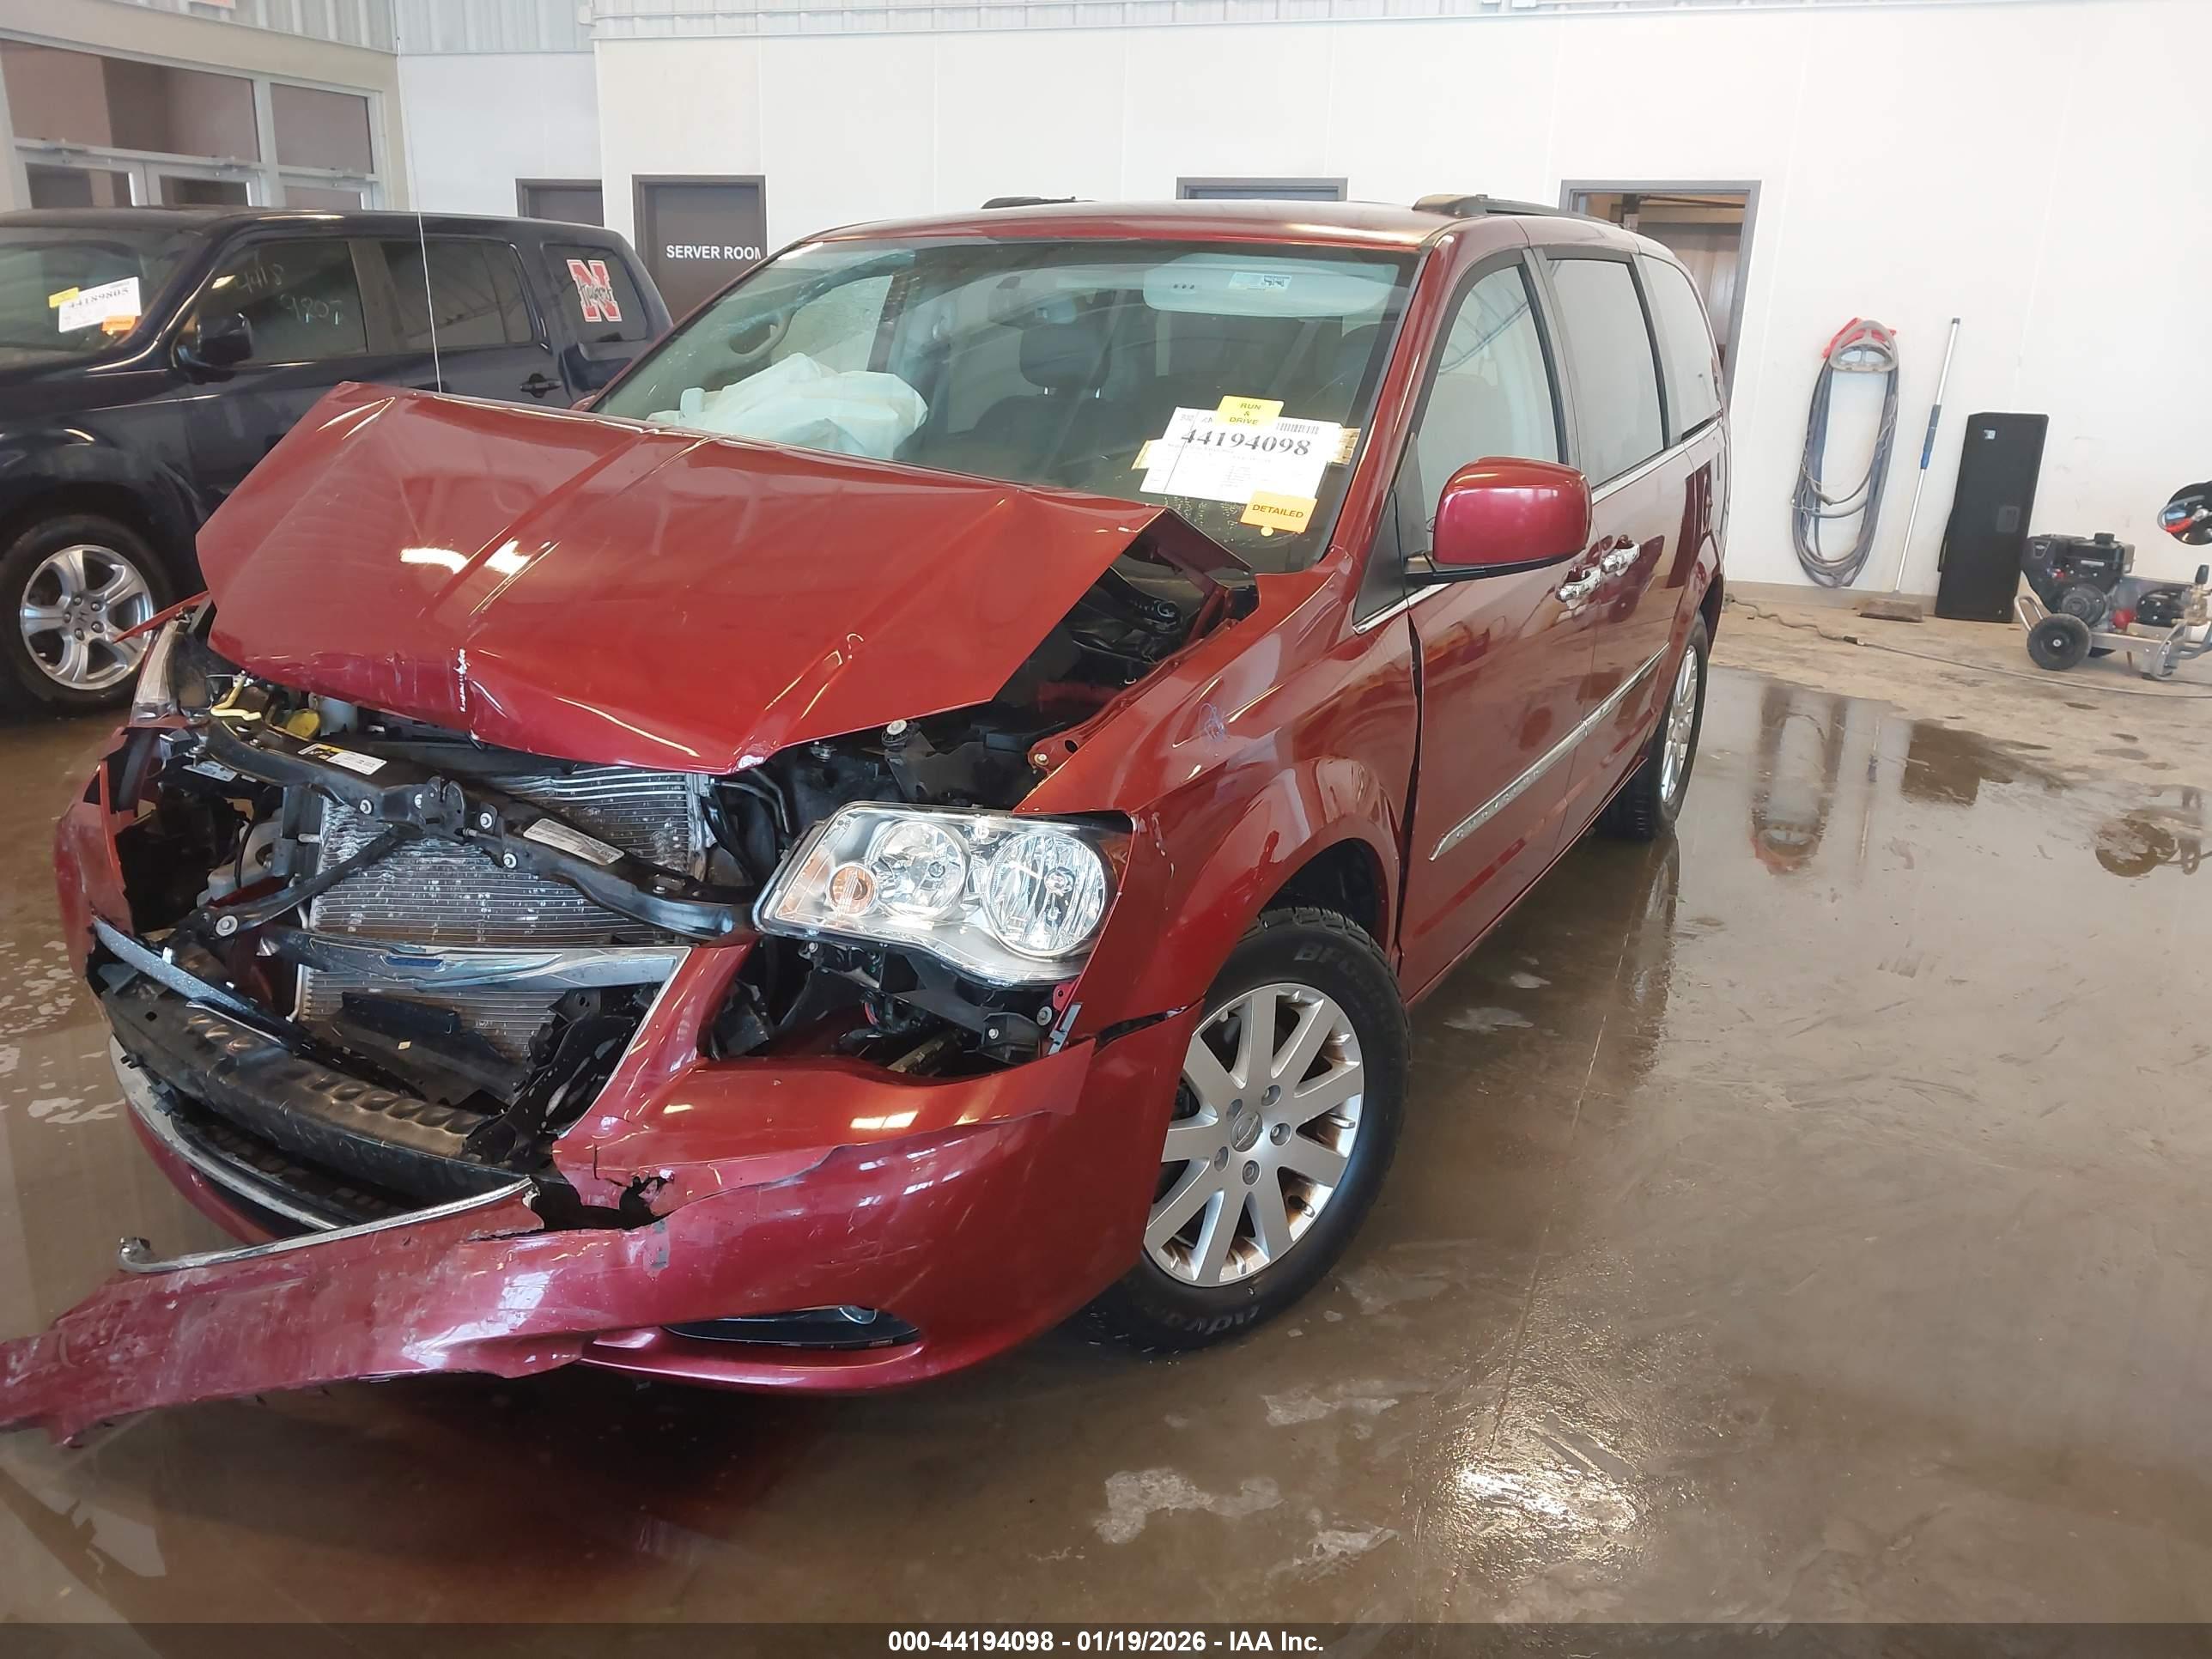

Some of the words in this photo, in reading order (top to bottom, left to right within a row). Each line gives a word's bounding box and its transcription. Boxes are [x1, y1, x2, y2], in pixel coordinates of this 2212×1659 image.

[666, 245, 720, 259] SERVER
[1239, 402, 1262, 411] RUN
[1229, 416, 1259, 425] DRIVE
[1181, 428, 1312, 455] 44194098
[1252, 503, 1304, 519] DETAILED
